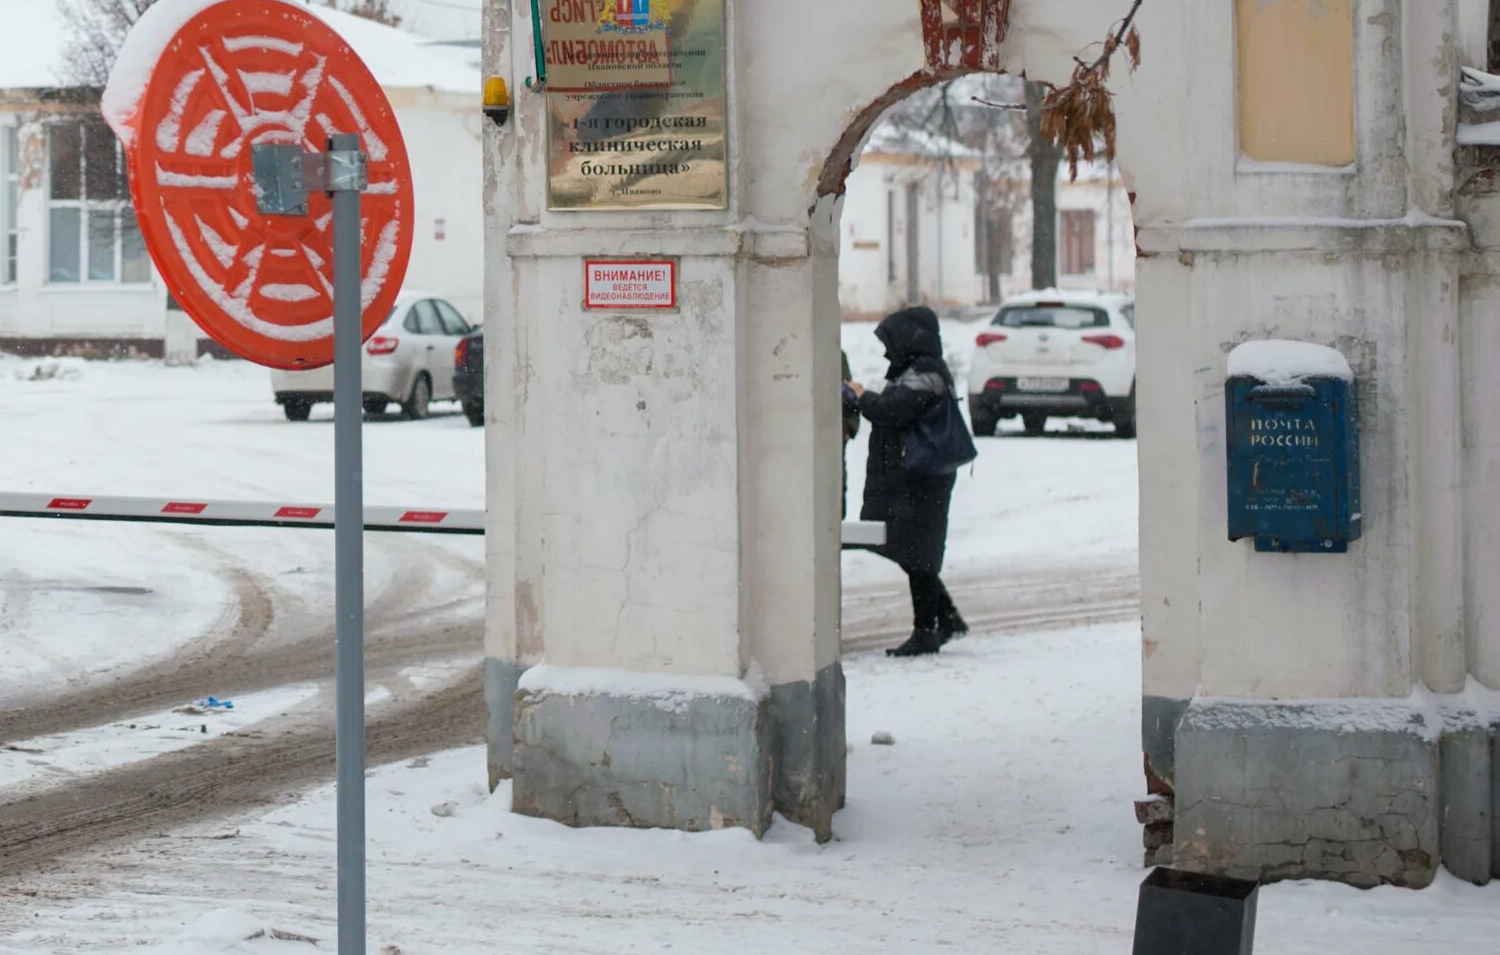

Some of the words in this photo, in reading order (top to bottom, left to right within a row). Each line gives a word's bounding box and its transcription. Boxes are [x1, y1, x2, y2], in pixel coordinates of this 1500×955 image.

[604, 116, 708, 132] городская
[569, 139, 702, 153] клиническая
[581, 160, 691, 176] больница»
[594, 270, 666, 281] ВНИМАНИЕ!
[590, 292, 670, 301] ВИДЕОНАБЛЮДЕНИЕ
[1251, 419, 1316, 431] ПОЧТА
[1251, 434, 1319, 447] РОССИИ
